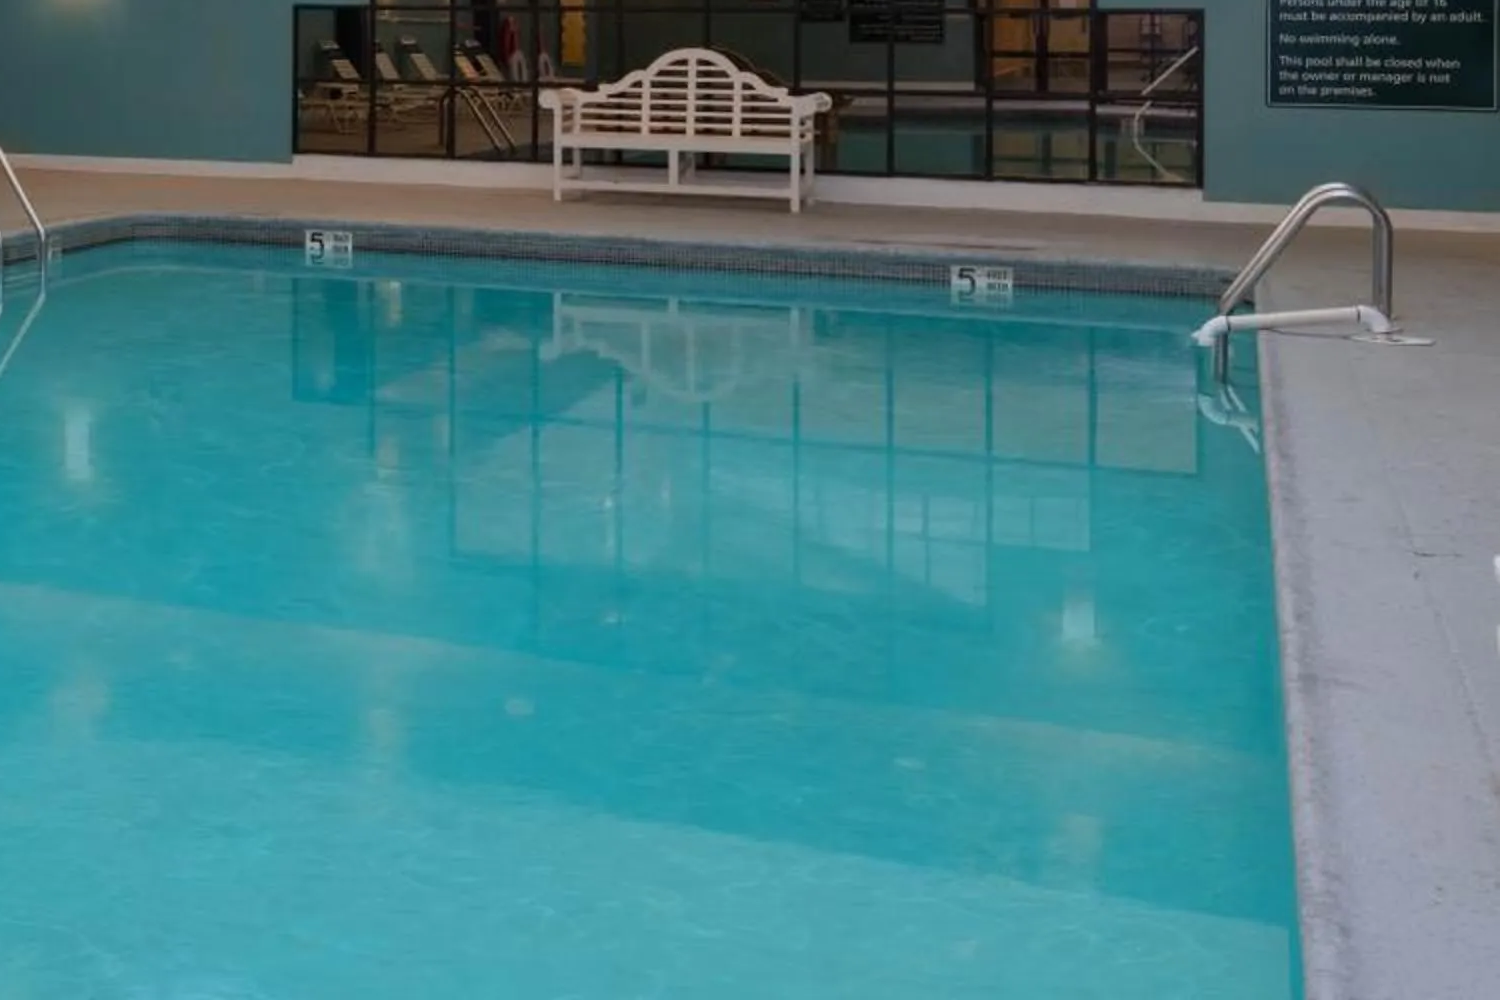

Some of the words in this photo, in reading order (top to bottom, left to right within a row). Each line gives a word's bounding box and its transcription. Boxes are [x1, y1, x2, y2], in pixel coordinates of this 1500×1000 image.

[1279, 12, 1307, 22] must
[1311, 12, 1326, 22] be
[1412, 12, 1426, 24] by
[1430, 13, 1447, 22] an
[1279, 34, 1296, 44] No
[1300, 34, 1360, 47] swimming
[1279, 55, 1303, 66] This
[1306, 56, 1333, 68] pool
[1335, 56, 1362, 67] shall
[1366, 56, 1381, 67] be
[1384, 57, 1422, 68] closed
[1425, 57, 1461, 68] when
[1279, 71, 1298, 80] the
[1302, 73, 1339, 81] owner
[1360, 73, 1413, 85] manager
[1417, 74, 1425, 83] is
[1429, 73, 1450, 83] not
[1279, 87, 1294, 95] on
[1298, 85, 1317, 95] the
[958, 268, 975, 297] 5
